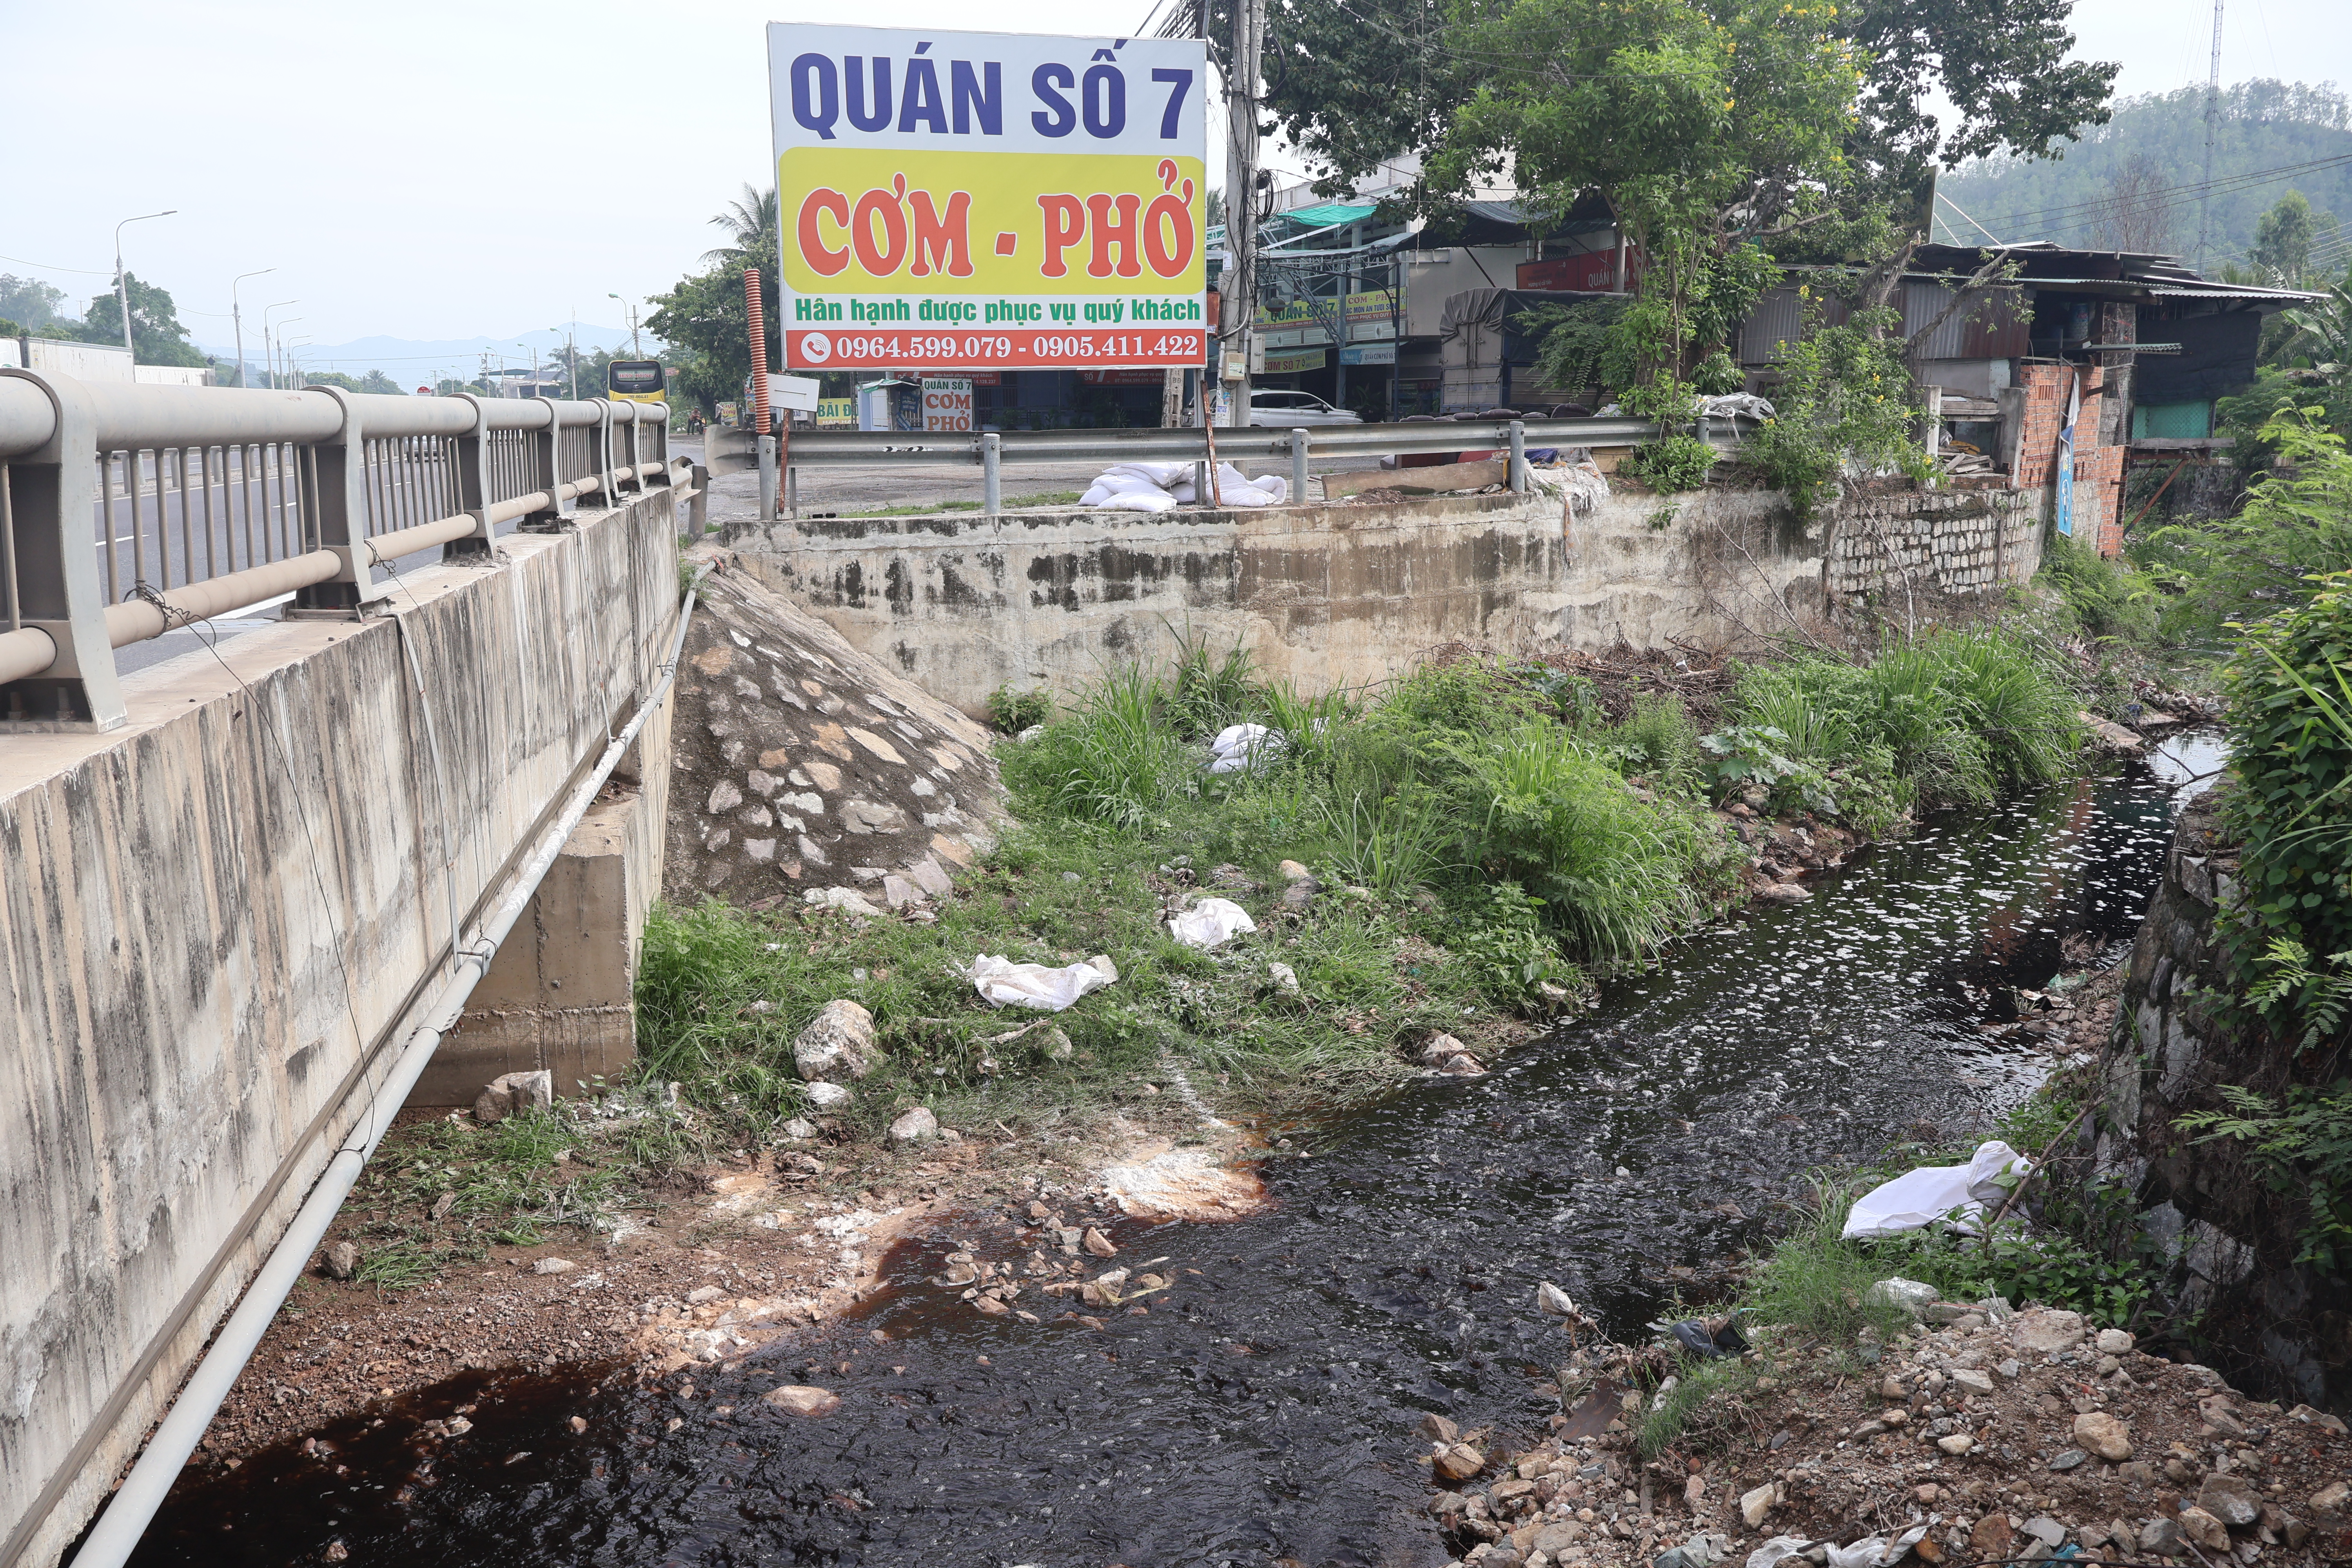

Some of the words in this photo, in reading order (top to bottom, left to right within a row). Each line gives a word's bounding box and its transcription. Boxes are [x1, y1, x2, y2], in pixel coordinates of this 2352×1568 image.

[790, 42, 1003, 140] QUÁN
[1031, 39, 1128, 139] SỐ
[1152, 68, 1193, 139] 7
[797, 172, 974, 278] CƠM
[1037, 159, 1195, 278] PHỞ
[1588, 268, 1609, 289] QUÁN
[1348, 295, 1368, 305] CƠM
[795, 298, 842, 321] Hân
[851, 299, 910, 326] hạnh
[919, 299, 976, 326] được
[985, 299, 1042, 326] phục
[1049, 303, 1076, 326] vụ
[1084, 299, 1124, 324] quý
[1132, 299, 1200, 321] khách
[1354, 305, 1365, 314] MÓN
[1366, 304, 1372, 312] ĂN
[837, 336, 1011, 359] 0964.599.079
[1033, 335, 1198, 357] 0905.411.422
[1283, 357, 1294, 370] SỐ
[1296, 359, 1301, 369] 7
[1365, 352, 1373, 361] QUÁN
[1084, 371, 1093, 381] SỐ
[924, 379, 949, 390] QUÁN
[951, 379, 964, 390] SỐ
[966, 382, 971, 390] 7
[926, 391, 971, 409] CƠM
[818, 402, 839, 417] BÃI
[927, 410, 970, 431] PHỞ
